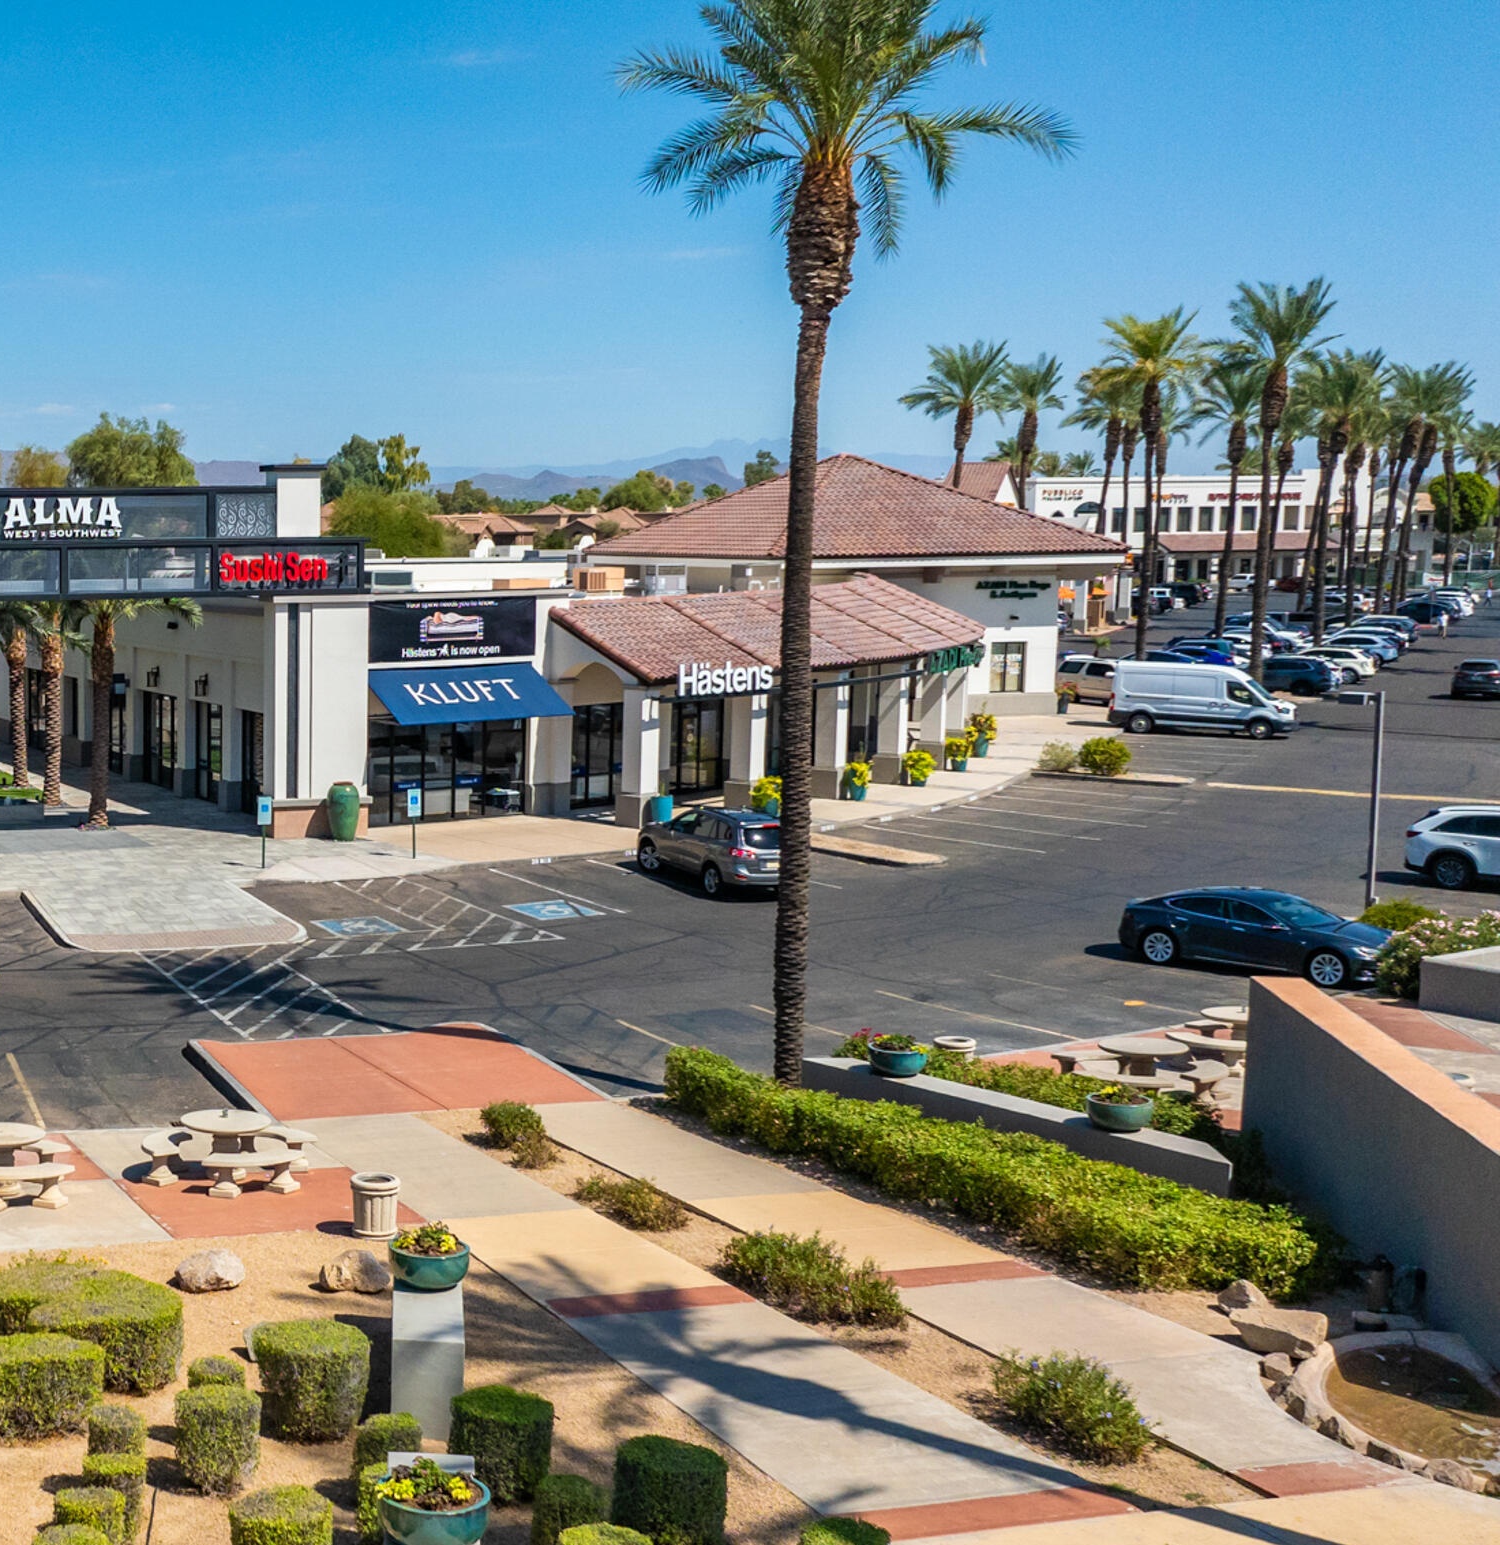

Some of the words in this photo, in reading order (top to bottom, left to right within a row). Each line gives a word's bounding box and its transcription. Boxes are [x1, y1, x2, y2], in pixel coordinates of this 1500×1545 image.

[3, 497, 122, 529] ALMA
[4, 530, 37, 538] WEST
[49, 529, 122, 538] SOUTHWEST
[219, 552, 283, 582] Sushi
[285, 552, 328, 582] Sen
[450, 645, 459, 655] is
[459, 646, 478, 655] now
[478, 645, 500, 656] open
[403, 678, 521, 706] KLUFT
[678, 661, 774, 696] Hästens
